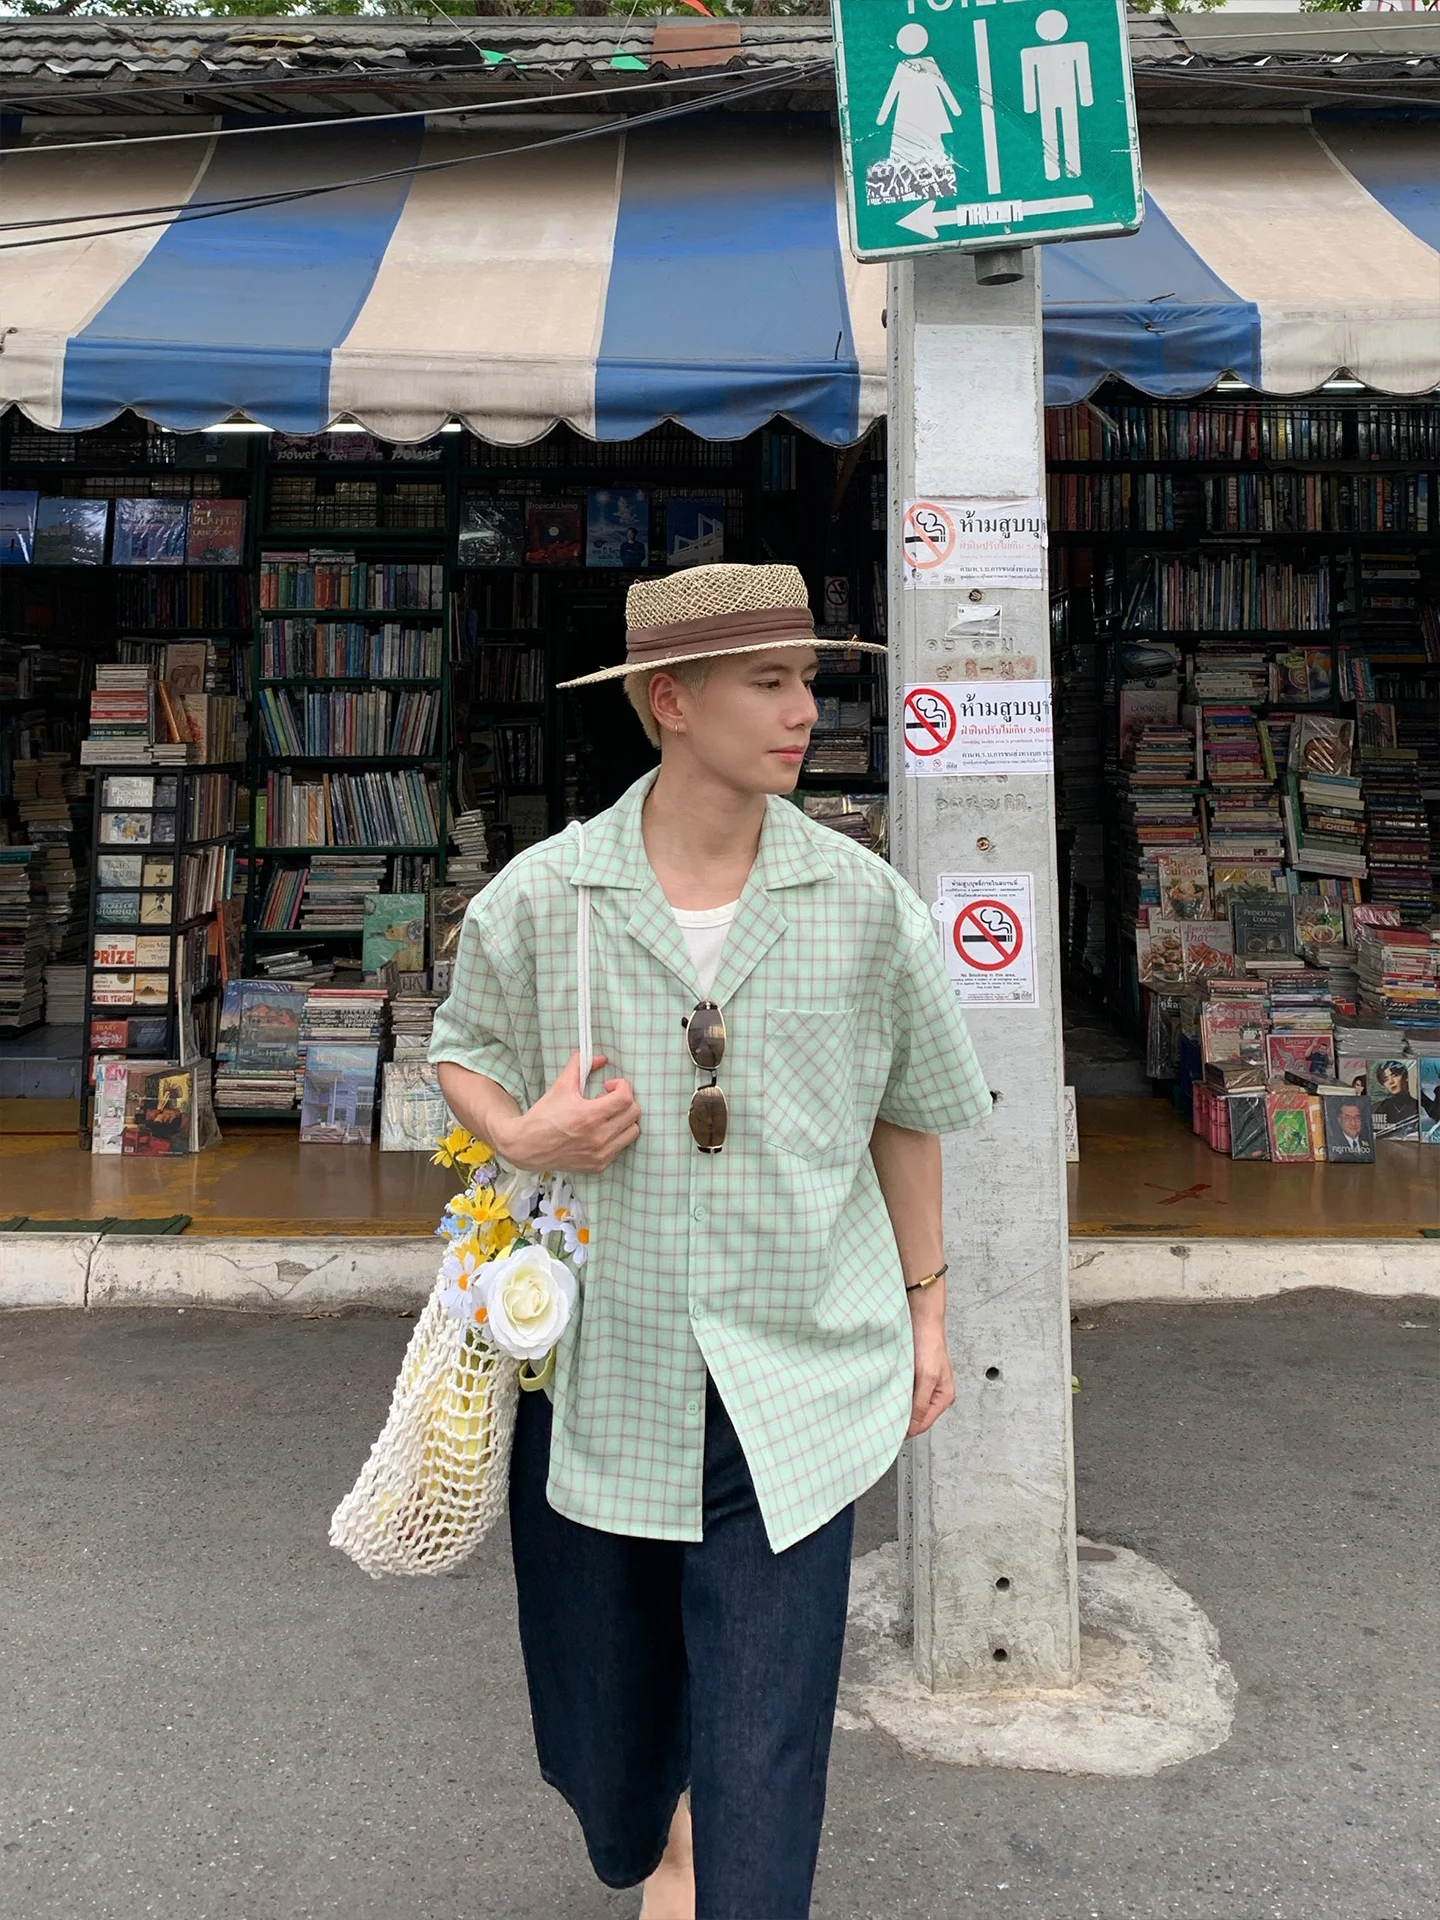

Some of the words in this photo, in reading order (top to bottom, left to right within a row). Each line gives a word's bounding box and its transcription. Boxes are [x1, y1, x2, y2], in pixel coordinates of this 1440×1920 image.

[277, 449, 319, 461] power
[529, 502, 556, 511] Tropical
[558, 502, 579, 511] Living
[959, 510, 1046, 540] ห้ามสูบบุ
[1130, 703, 1169, 714] cookies
[131, 778, 151, 788] The
[111, 787, 151, 798] Phoenix
[115, 796, 151, 807] Project
[1164, 864, 1204, 877] cuisine
[1243, 909, 1265, 917] FRENCH
[1266, 910, 1286, 918] FAMILY
[1252, 916, 1278, 924] COOKING
[1185, 932, 1208, 943] Thai
[93, 950, 136, 965] PRIZE
[93, 995, 108, 1003] ANIEL
